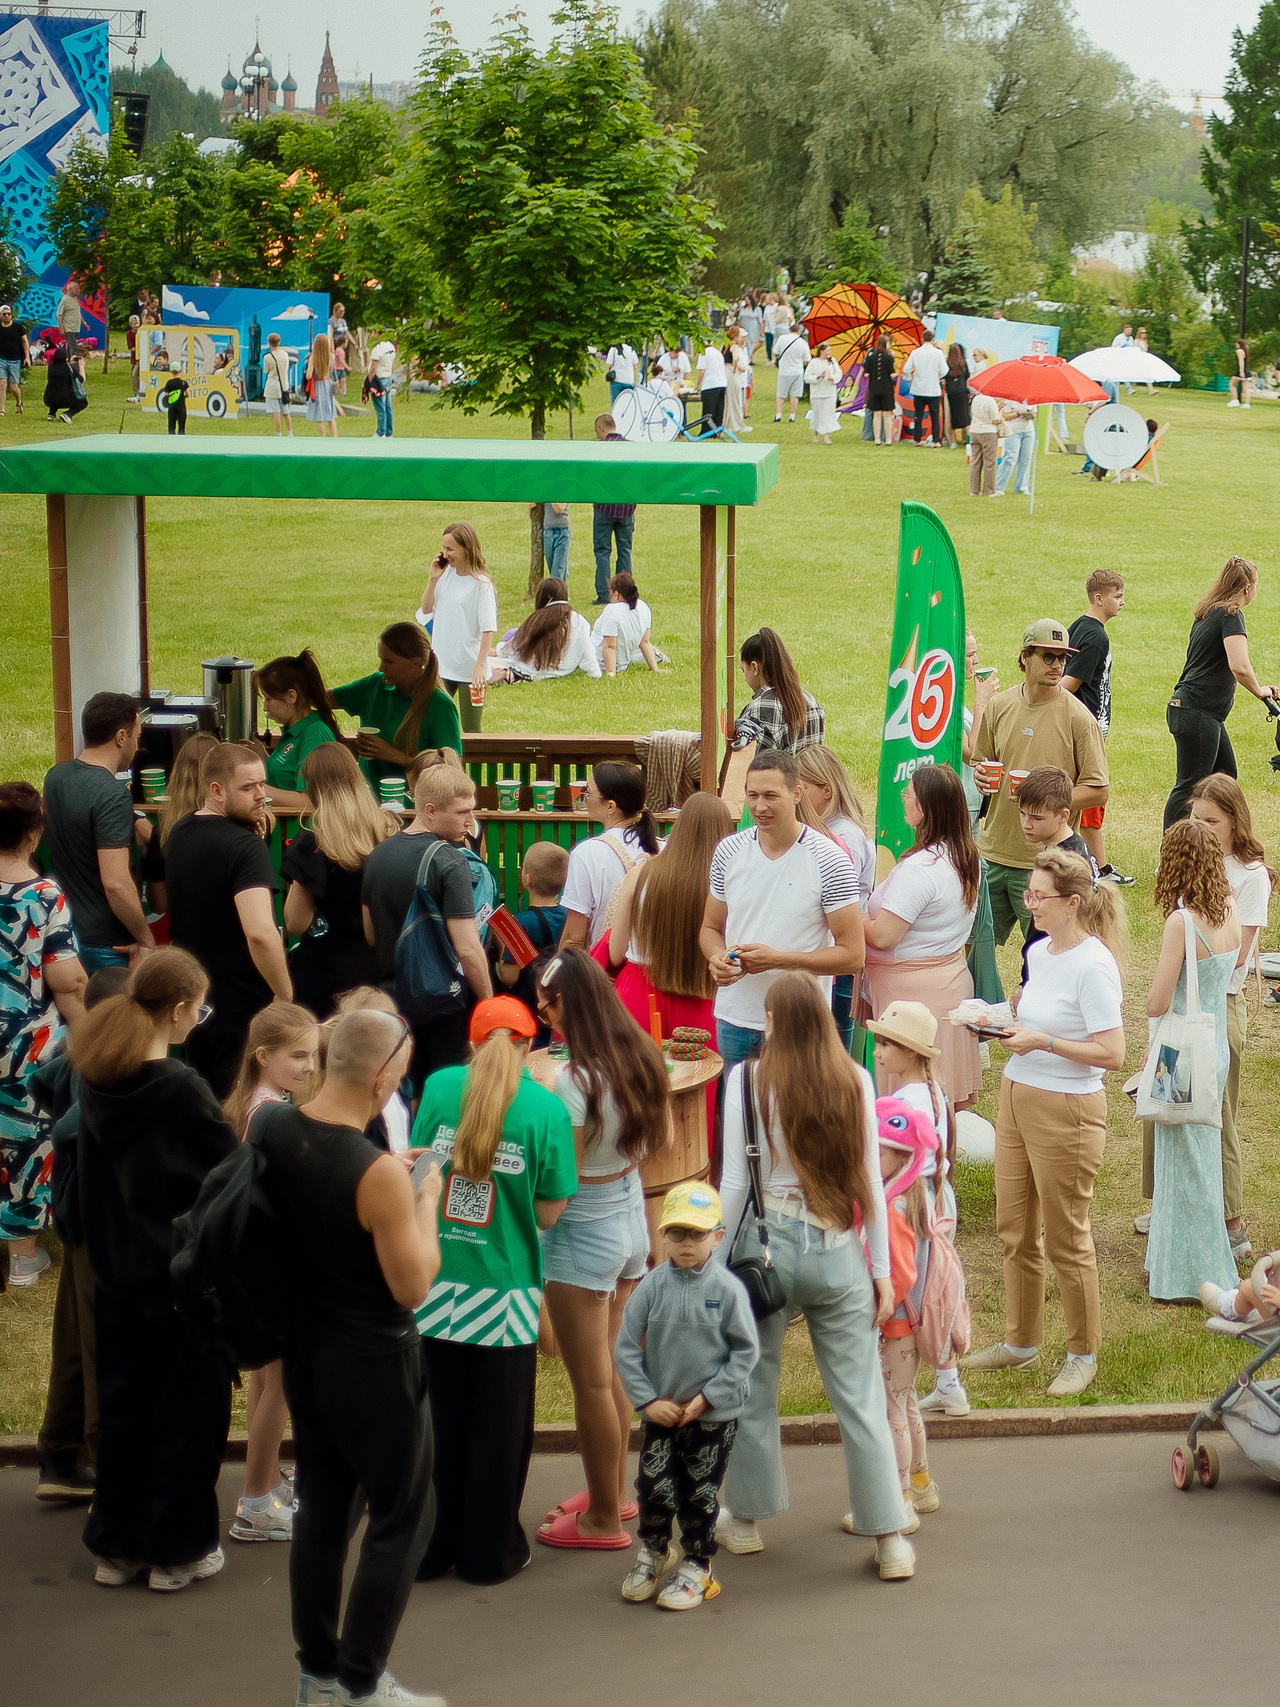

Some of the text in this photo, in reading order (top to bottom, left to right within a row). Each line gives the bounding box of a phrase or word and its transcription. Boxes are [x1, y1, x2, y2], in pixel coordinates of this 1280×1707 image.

[498, 1140, 525, 1155] вас
[451, 1226, 477, 1238] Выгода
[444, 1233, 488, 1246] приложении
